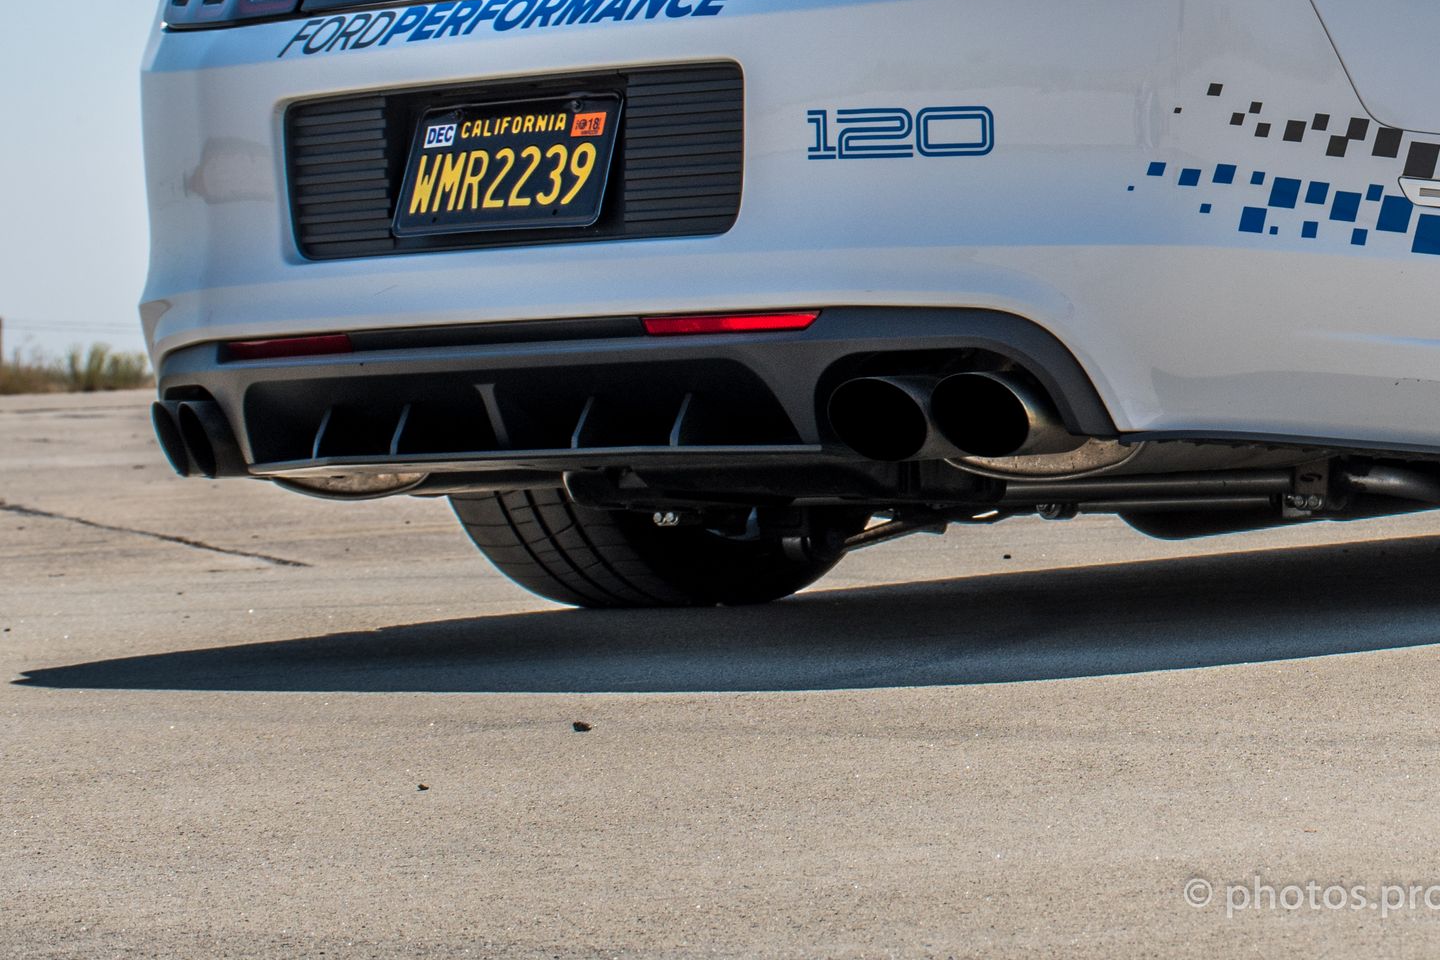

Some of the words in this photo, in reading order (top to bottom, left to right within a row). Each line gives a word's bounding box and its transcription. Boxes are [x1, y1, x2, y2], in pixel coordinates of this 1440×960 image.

[426, 125, 454, 145] DEC
[461, 113, 567, 139] CALIFORNIA
[807, 105, 995, 160] 120
[409, 142, 597, 215] WMR2239
